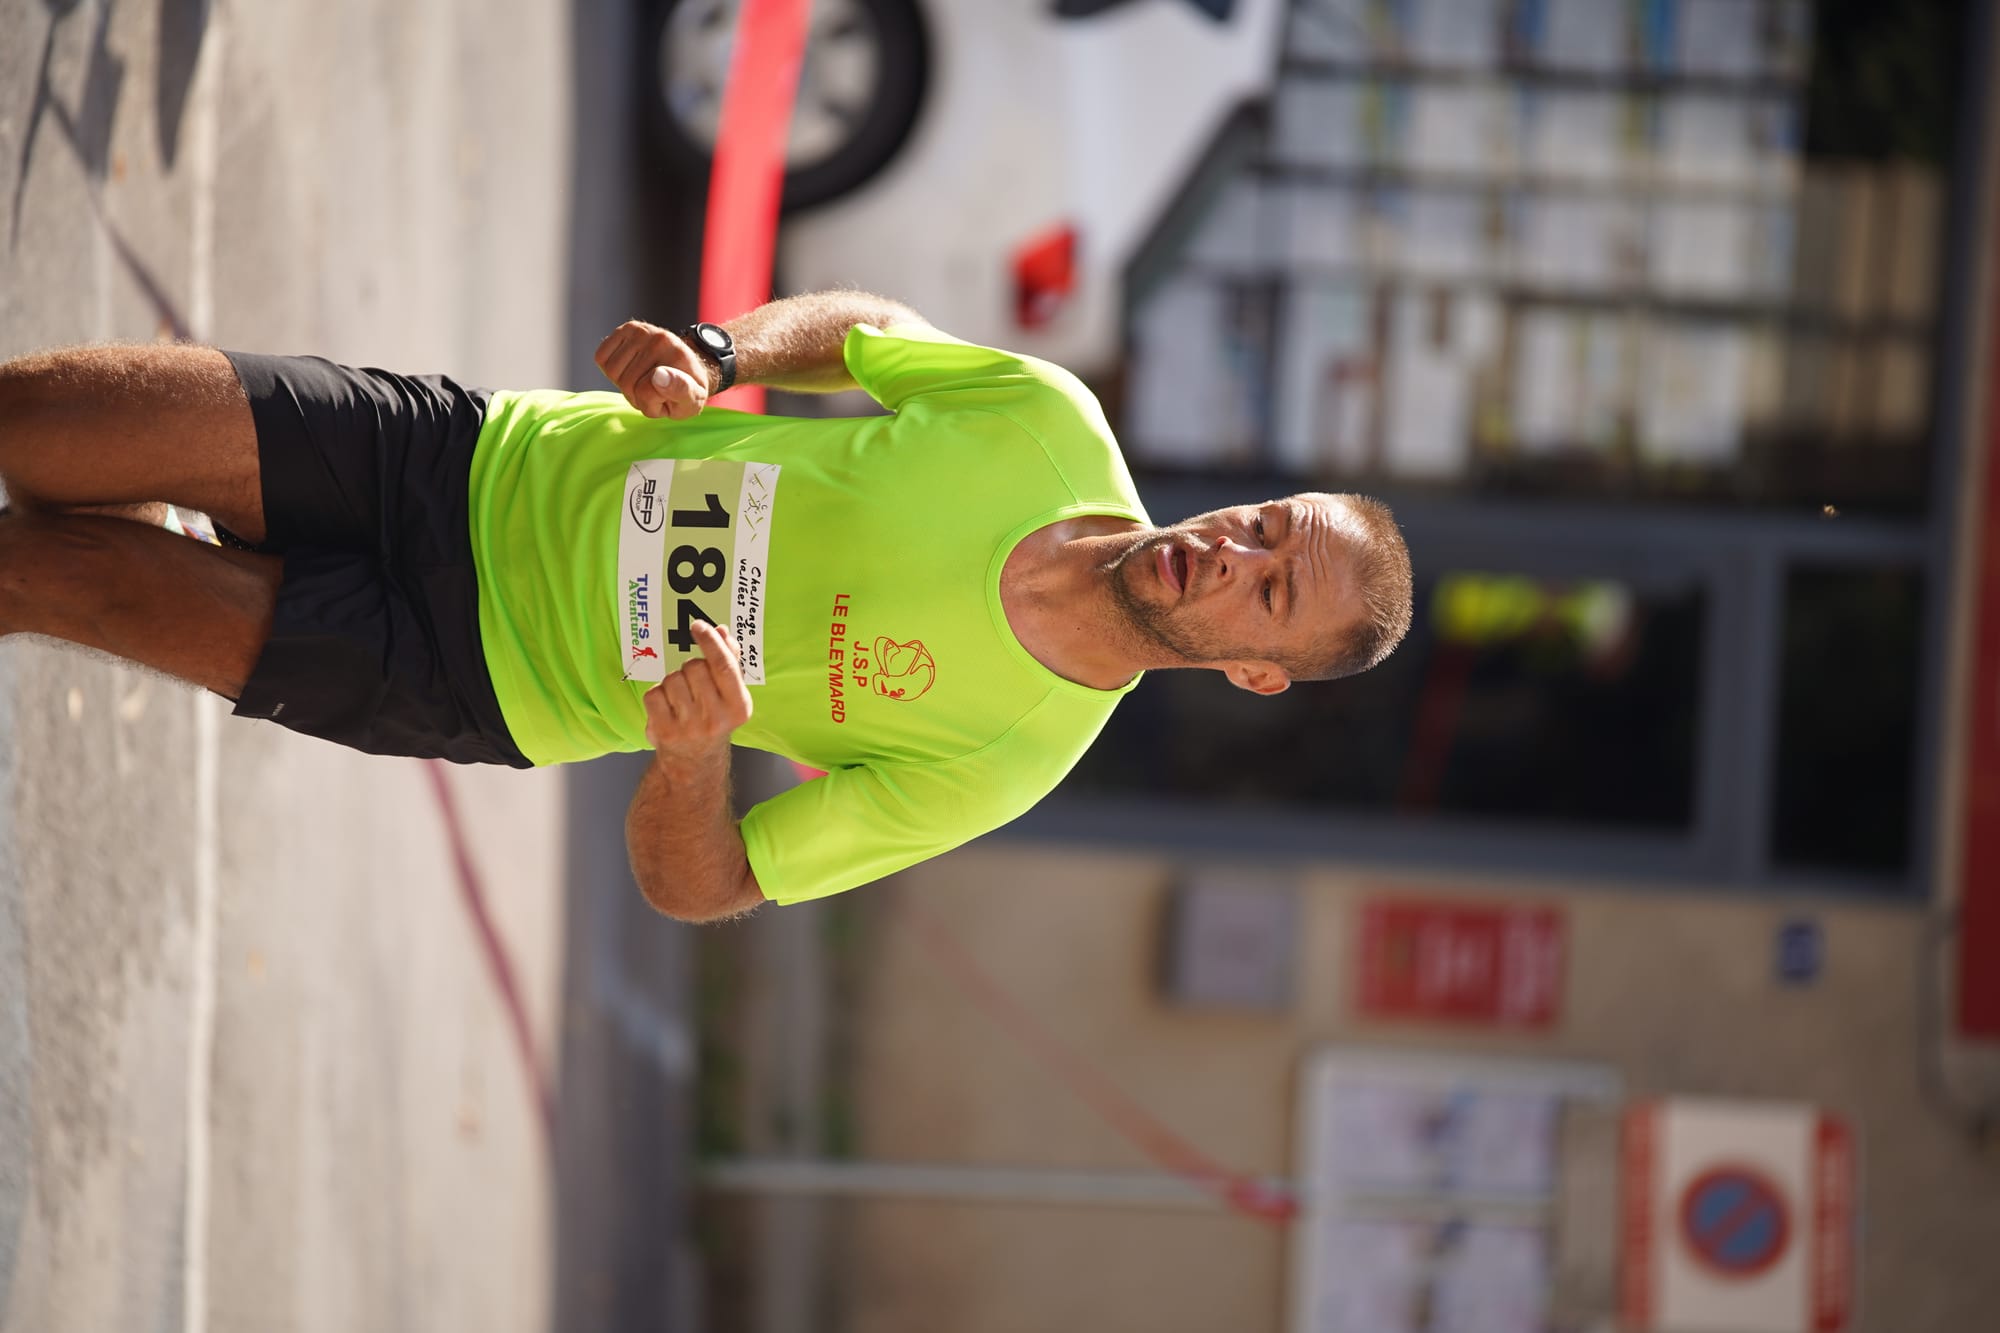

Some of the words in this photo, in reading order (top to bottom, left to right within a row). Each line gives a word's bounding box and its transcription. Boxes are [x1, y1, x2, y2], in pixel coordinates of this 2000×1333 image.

[640, 480, 656, 525] BFP
[667, 493, 730, 652] 184
[738, 559, 748, 607] vallées
[629, 580, 640, 645] Aventure
[637, 574, 649, 639] TUFF'S
[745, 567, 761, 637] Challenge
[833, 594, 850, 617] LE
[749, 645, 758, 668] des
[829, 623, 846, 724] BLEYMARD
[853, 641, 869, 687] J.S.P
